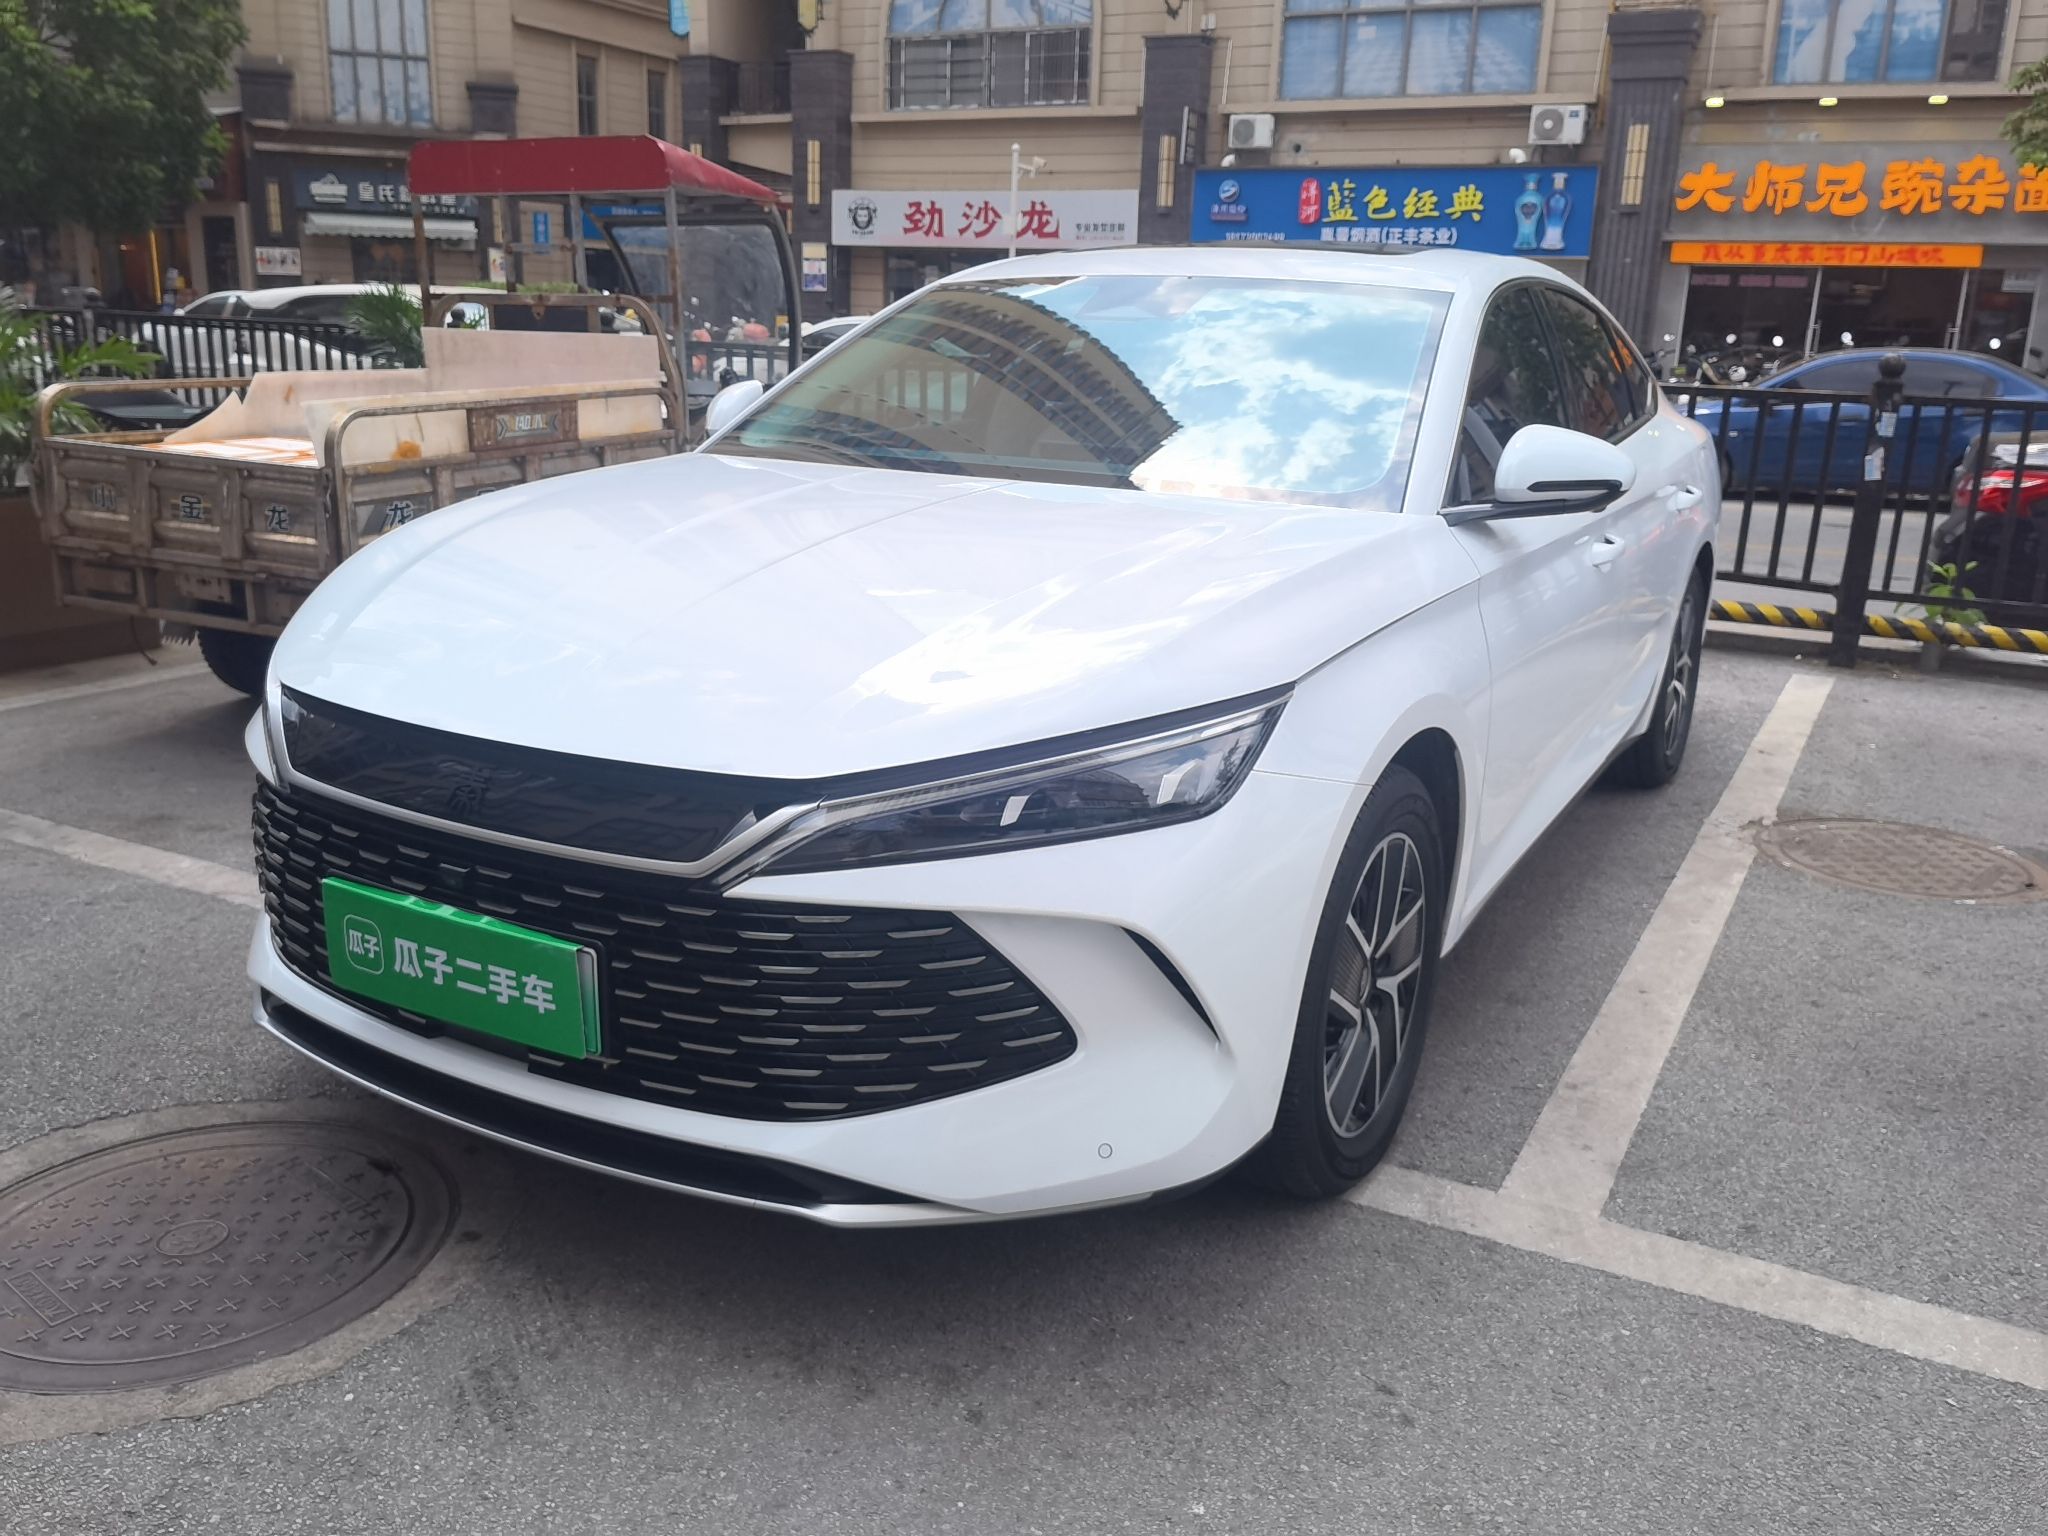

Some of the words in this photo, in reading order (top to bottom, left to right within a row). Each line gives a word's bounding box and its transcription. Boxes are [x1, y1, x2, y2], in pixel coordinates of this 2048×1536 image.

[902, 199, 1061, 240] 劲沙龙
[1321, 178, 1485, 222] 蓝色经典
[348, 928, 380, 961] 瓜子
[393, 937, 557, 1015] 瓜子二手车
